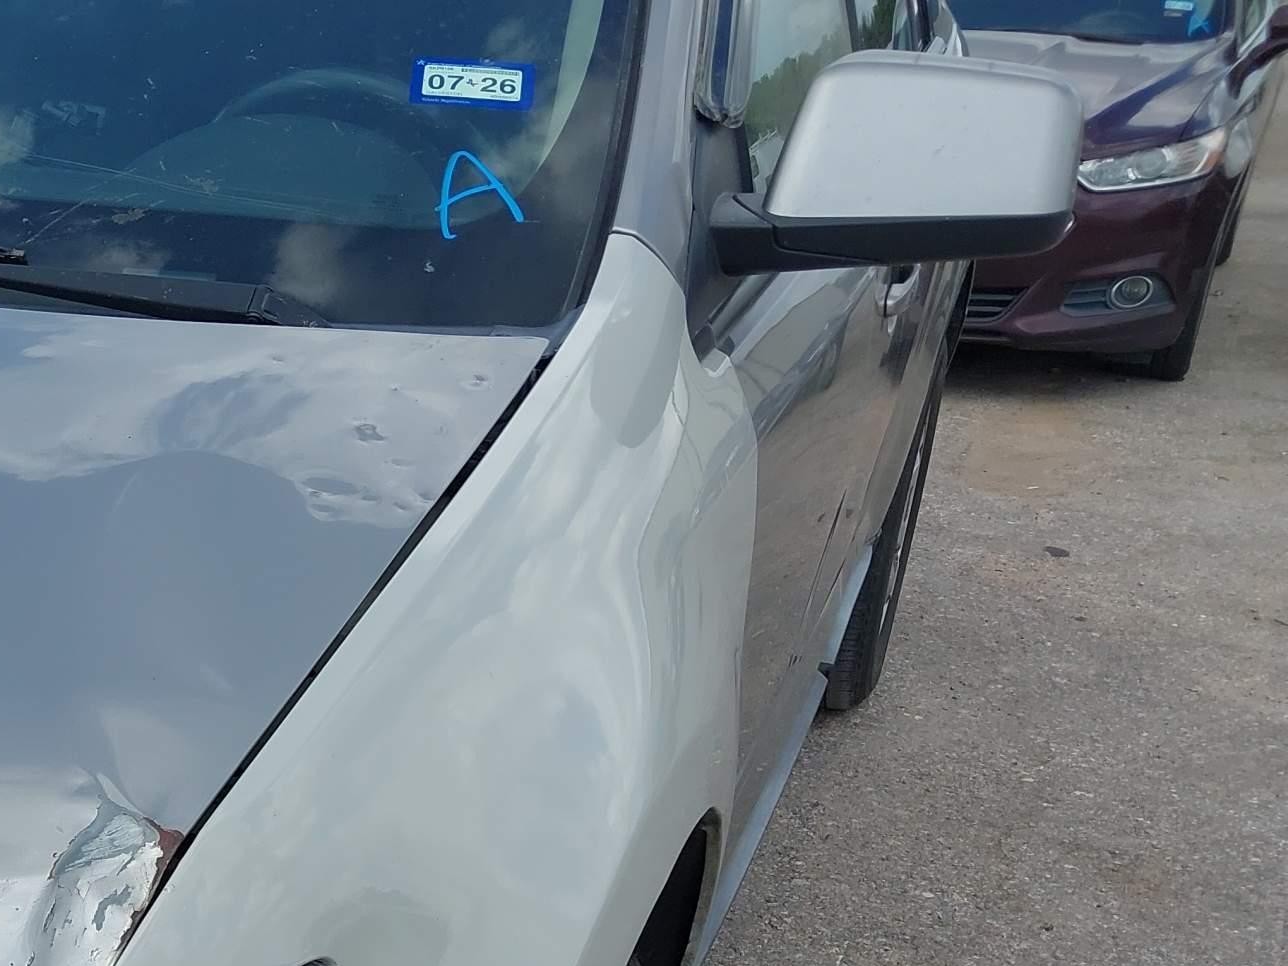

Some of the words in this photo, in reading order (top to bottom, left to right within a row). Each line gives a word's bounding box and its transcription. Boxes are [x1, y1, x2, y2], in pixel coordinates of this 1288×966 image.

[427, 73, 465, 91] 07
[479, 76, 516, 95] 26
[435, 150, 524, 240] A
